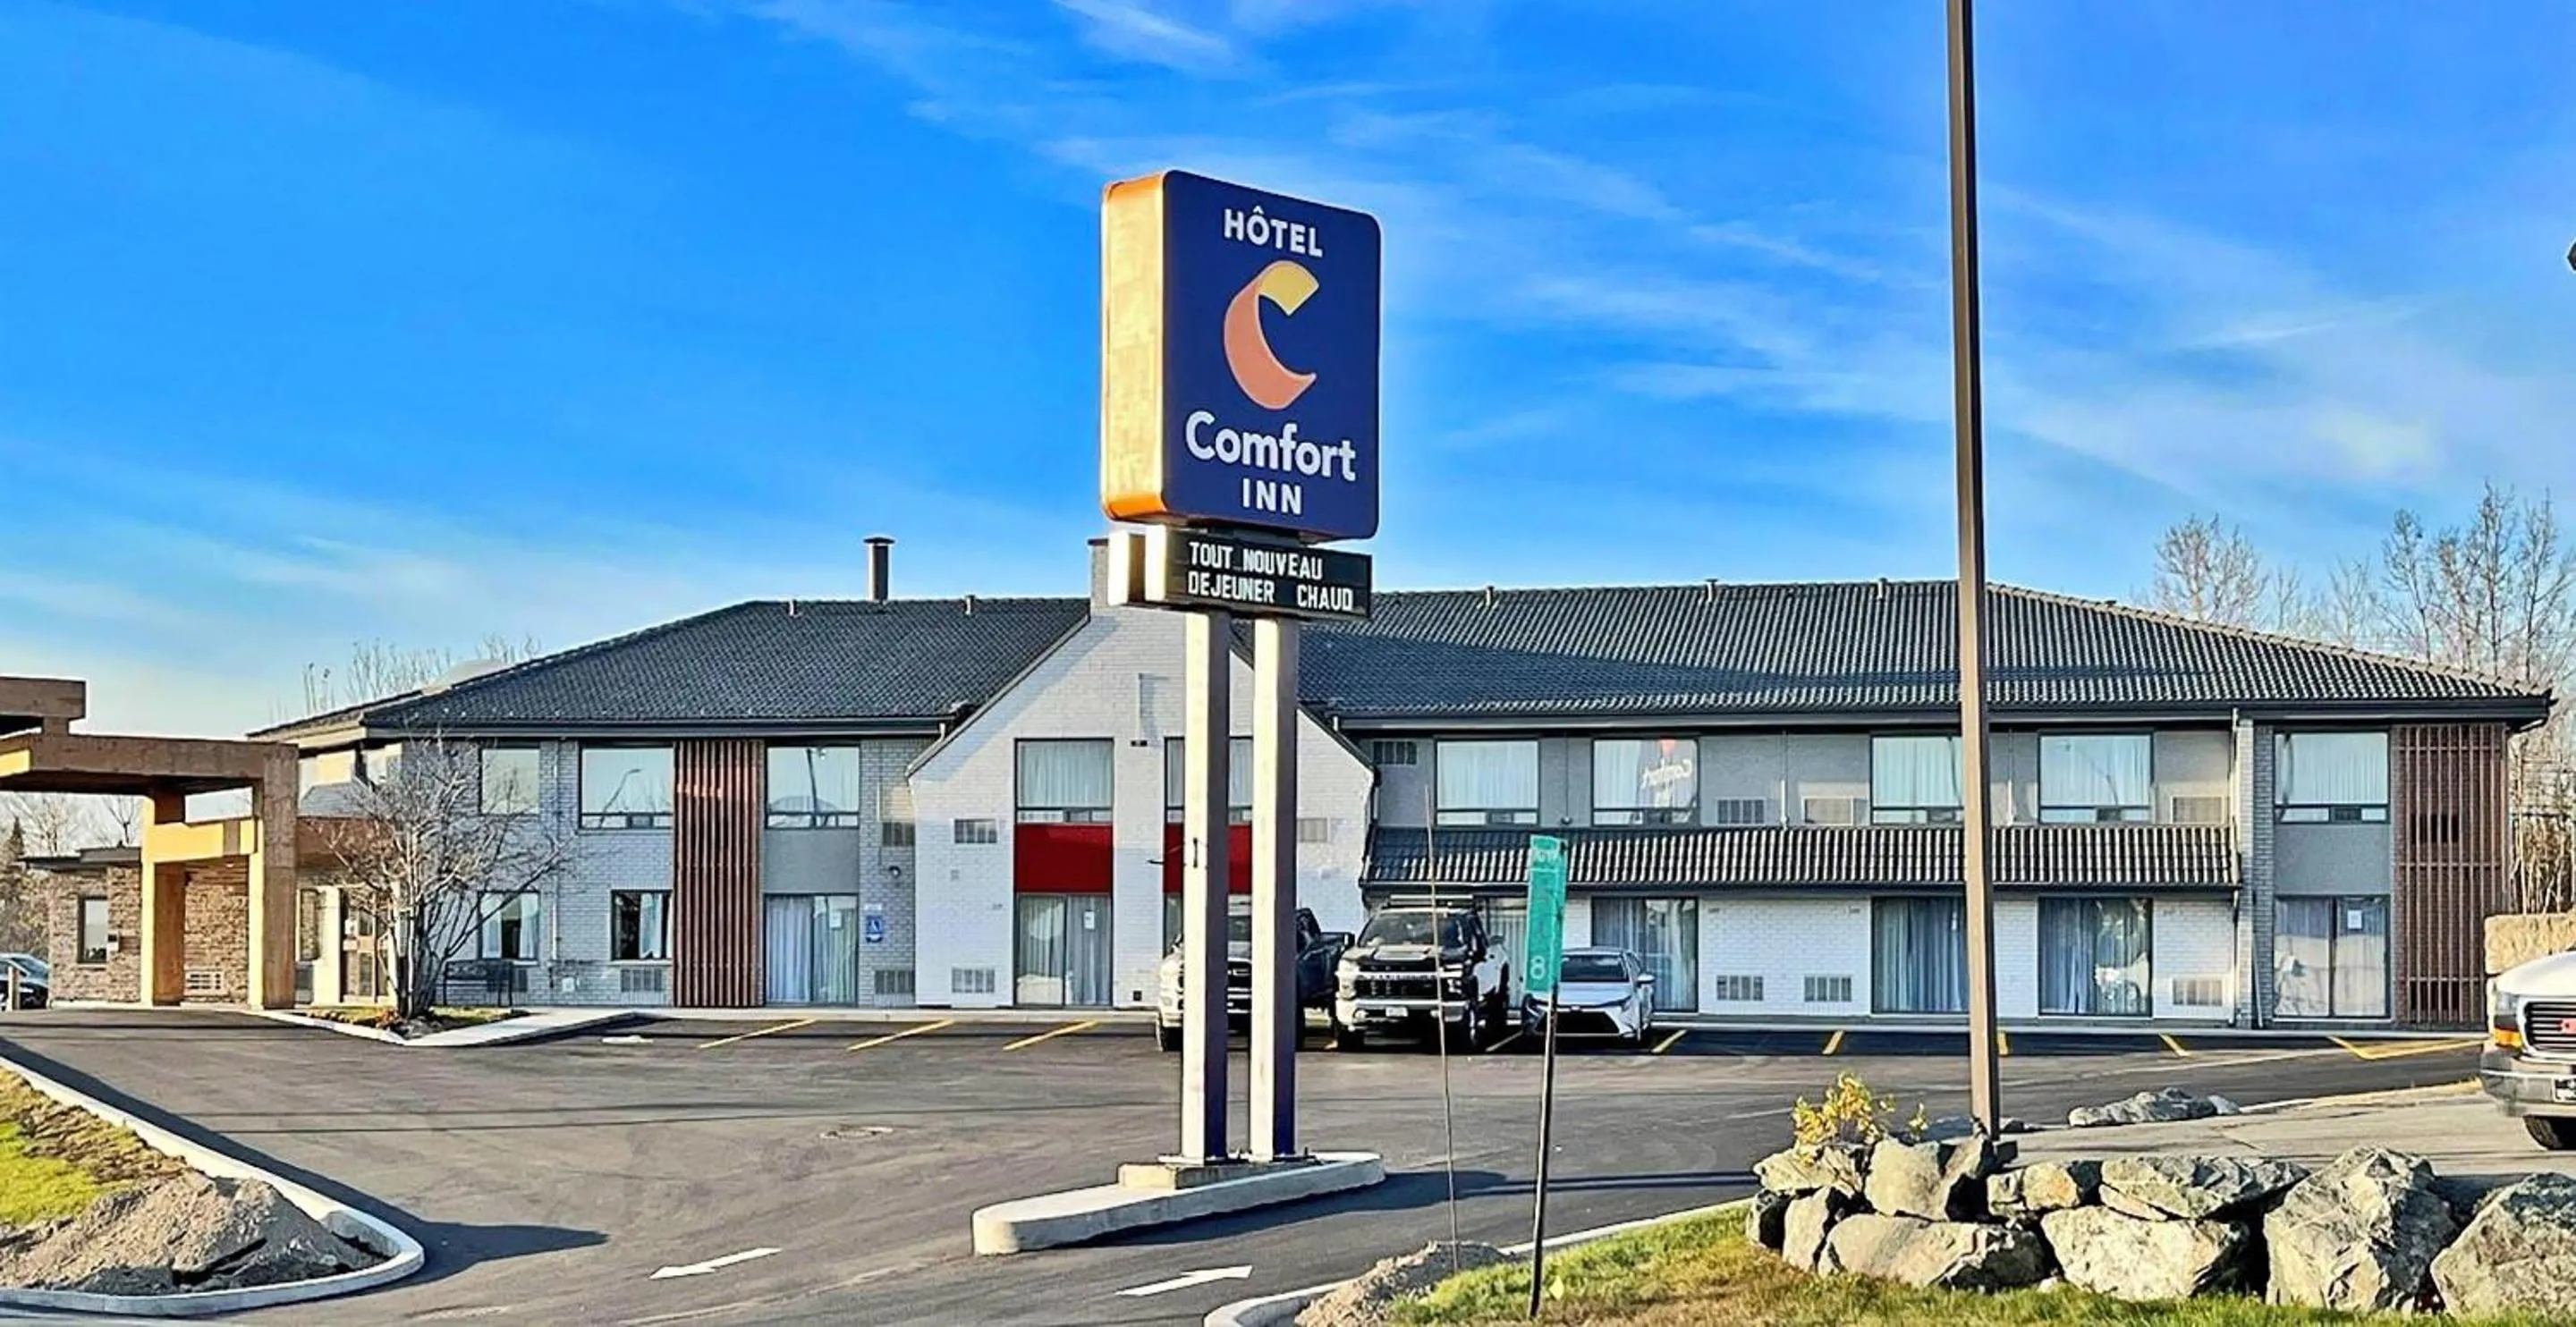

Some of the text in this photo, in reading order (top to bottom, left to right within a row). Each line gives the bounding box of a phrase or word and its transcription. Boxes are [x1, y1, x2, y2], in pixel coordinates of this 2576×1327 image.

[1224, 206, 1324, 258] HÔTEL
[1184, 410, 1357, 482] Comfort
[1242, 478, 1302, 515] INN
[1188, 542, 1323, 580] TOUT NOUVEAU
[1188, 571, 1354, 612] DEJEUNER CHAUD
[1530, 955, 1546, 980] 8
